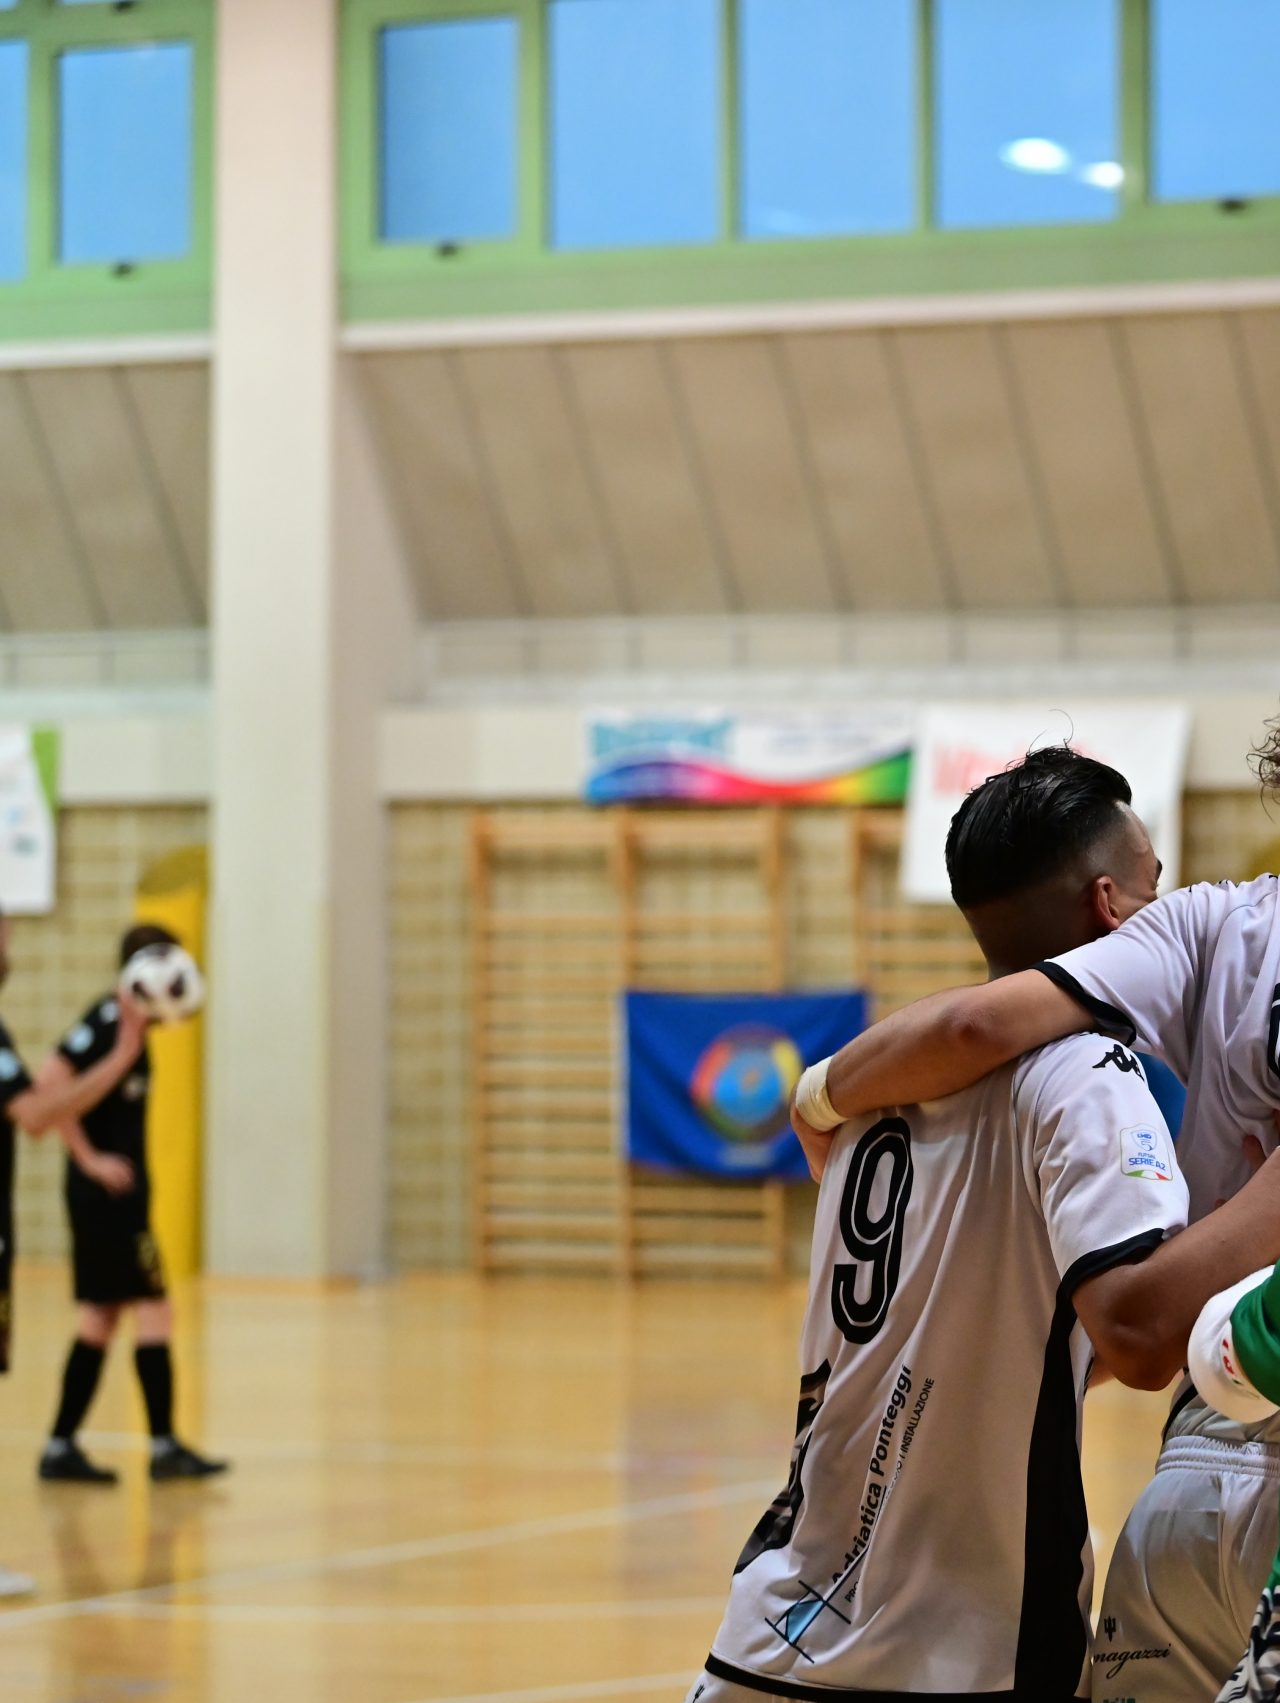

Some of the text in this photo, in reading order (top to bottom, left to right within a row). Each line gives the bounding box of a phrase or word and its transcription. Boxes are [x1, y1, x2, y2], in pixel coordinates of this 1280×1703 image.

[1128, 1157, 1166, 1171] SERIE A2
[831, 1117, 913, 1345] 9
[870, 1364, 912, 1477] Ponteggi
[900, 1378, 934, 1453] INSTALLAZIONE
